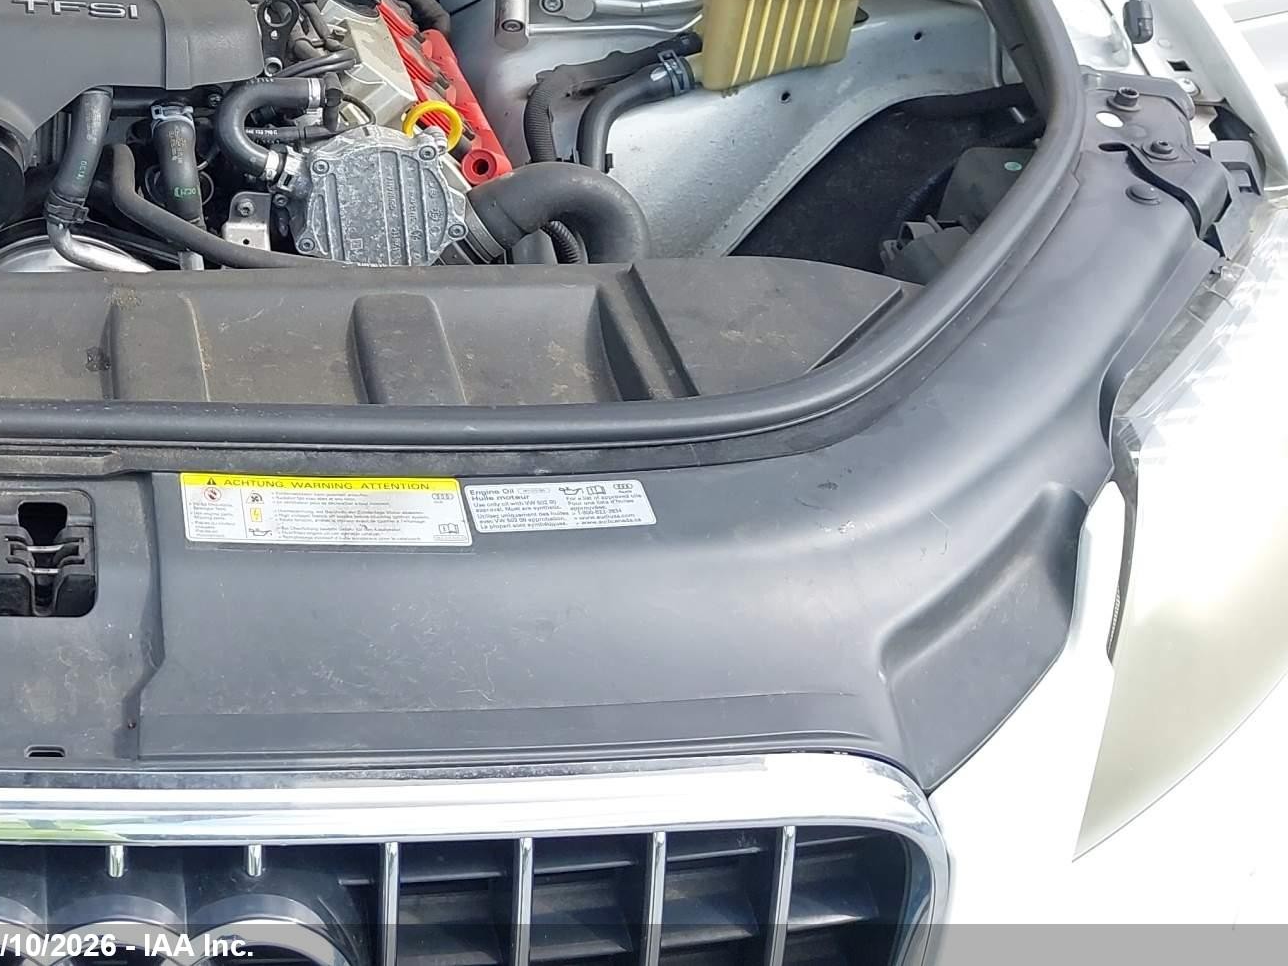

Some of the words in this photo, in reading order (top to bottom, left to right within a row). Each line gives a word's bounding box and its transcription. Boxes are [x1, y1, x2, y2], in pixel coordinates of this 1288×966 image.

[224, 479, 284, 488] ACHTUNG
[291, 481, 353, 490] WARNING
[360, 482, 430, 490] ATTENTION
